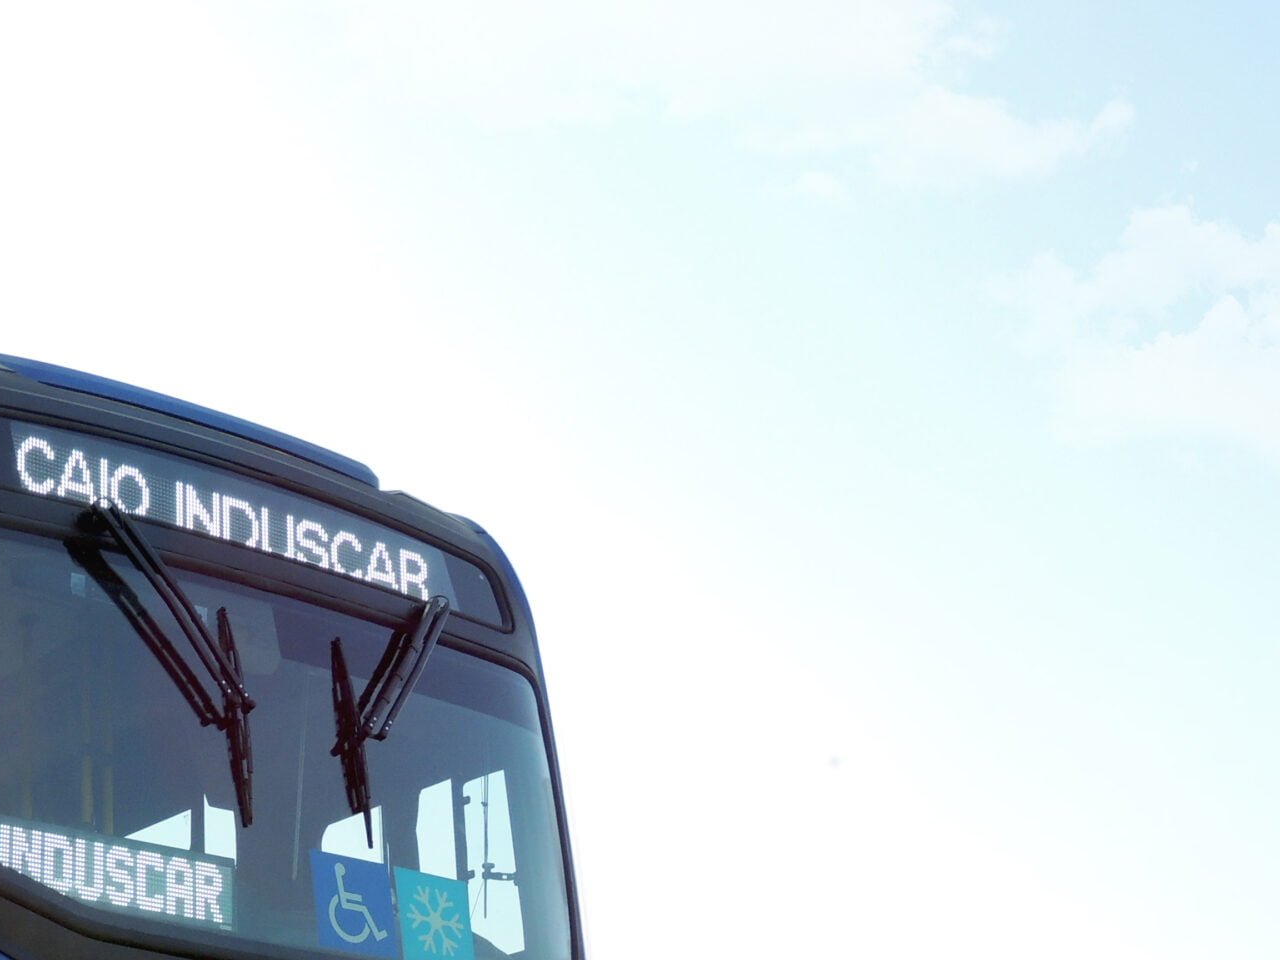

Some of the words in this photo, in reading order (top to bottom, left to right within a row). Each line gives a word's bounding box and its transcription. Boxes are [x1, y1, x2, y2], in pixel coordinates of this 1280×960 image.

[17, 436, 149, 516] CAIO
[176, 481, 429, 602] INDUSCAR
[0, 824, 223, 923] INDUSCAR
